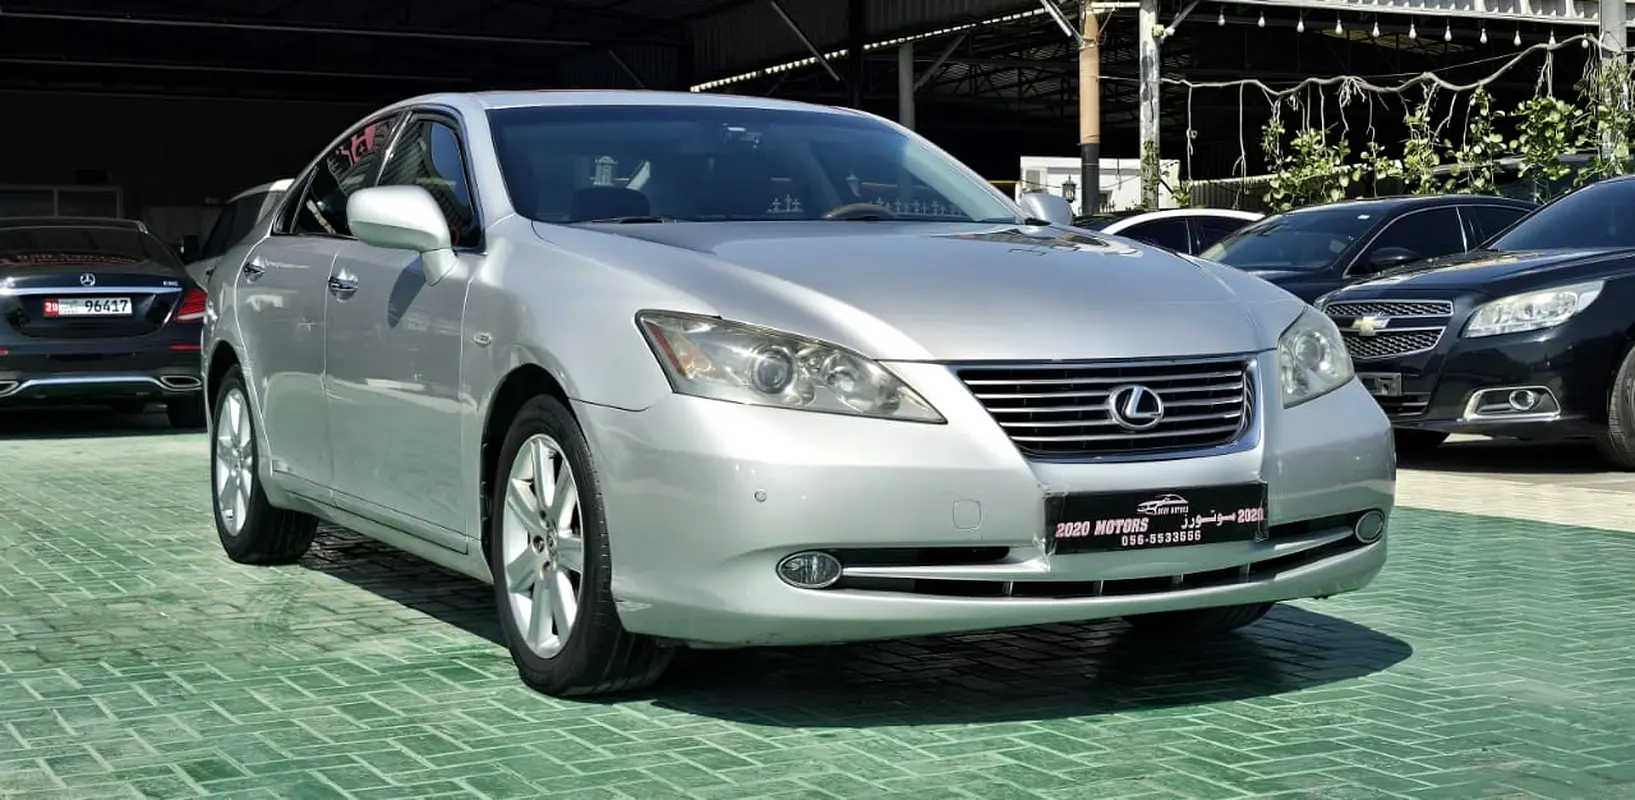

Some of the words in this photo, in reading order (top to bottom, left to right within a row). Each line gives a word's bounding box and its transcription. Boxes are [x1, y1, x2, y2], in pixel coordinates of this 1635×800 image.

[84, 299, 128, 313] 96417
[1237, 507, 1264, 524] 2020
[1055, 520, 1090, 538] 2020
[1094, 517, 1149, 536] MOTORS
